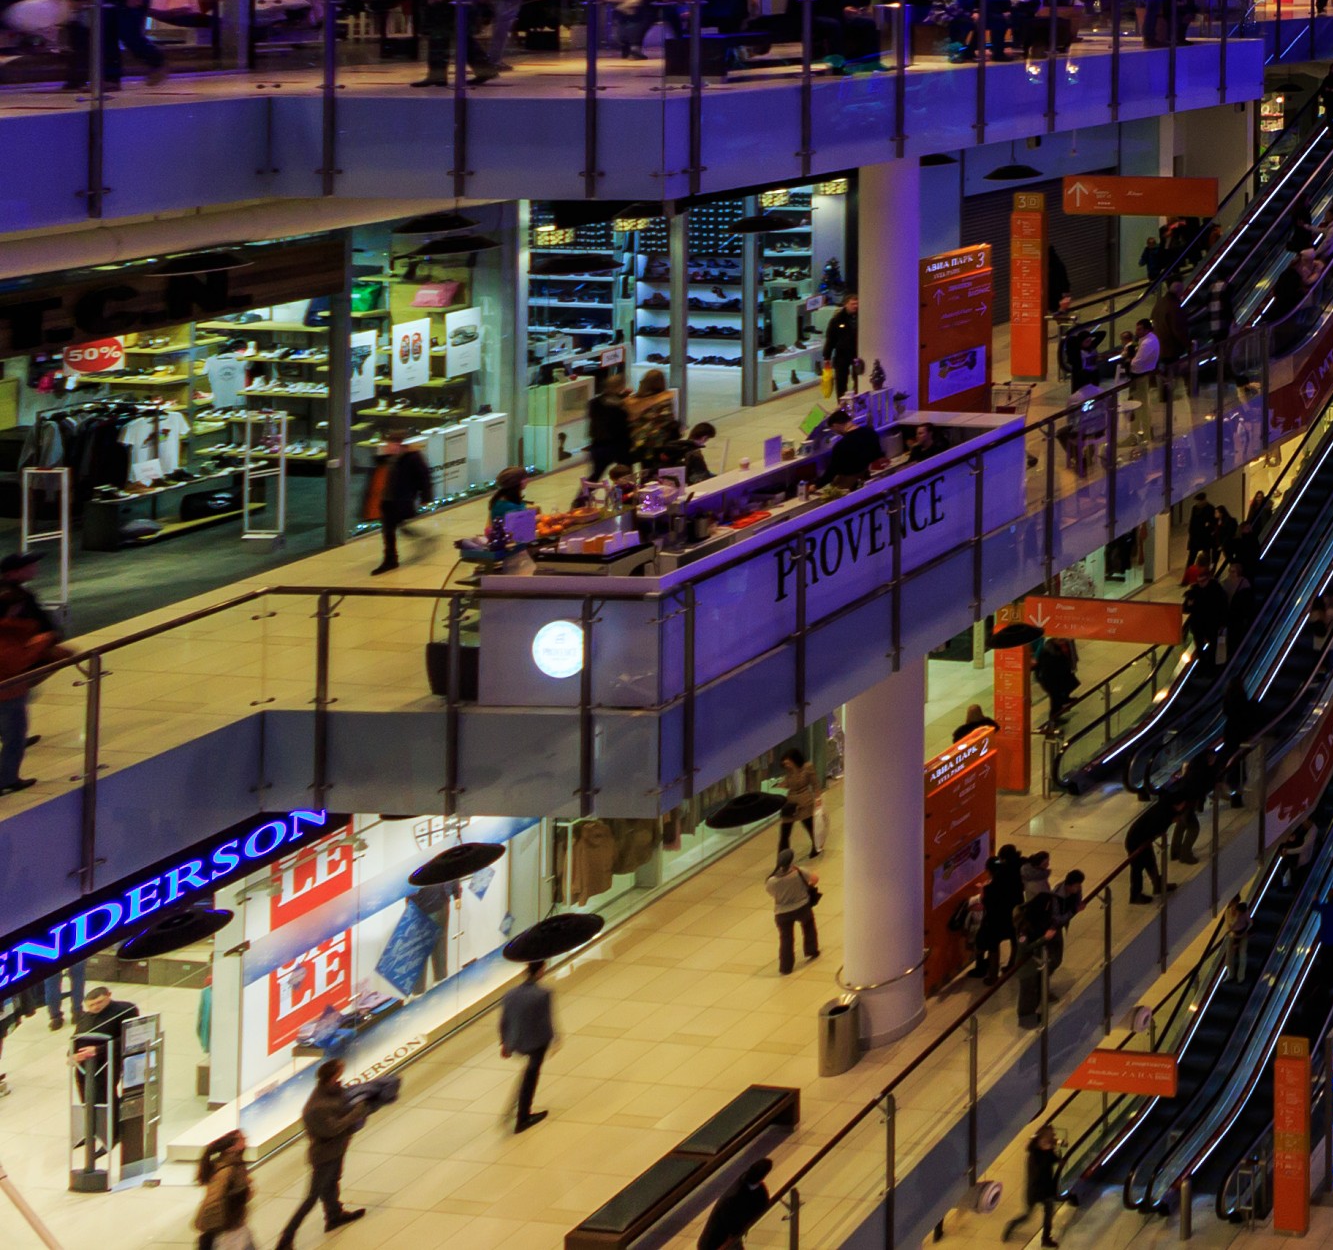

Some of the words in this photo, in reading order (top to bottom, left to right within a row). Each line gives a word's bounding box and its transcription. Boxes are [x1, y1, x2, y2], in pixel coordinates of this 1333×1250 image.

[1018, 196, 1026, 208] 3
[925, 260, 949, 273] АВИА
[951, 254, 974, 268] ПАРК
[976, 251, 986, 268] 3
[68, 345, 122, 363] 50%
[1001, 609, 1009, 622] 2
[980, 737, 989, 757] 2
[0, 809, 327, 990] NDERSON
[1281, 1042, 1289, 1055] 1
